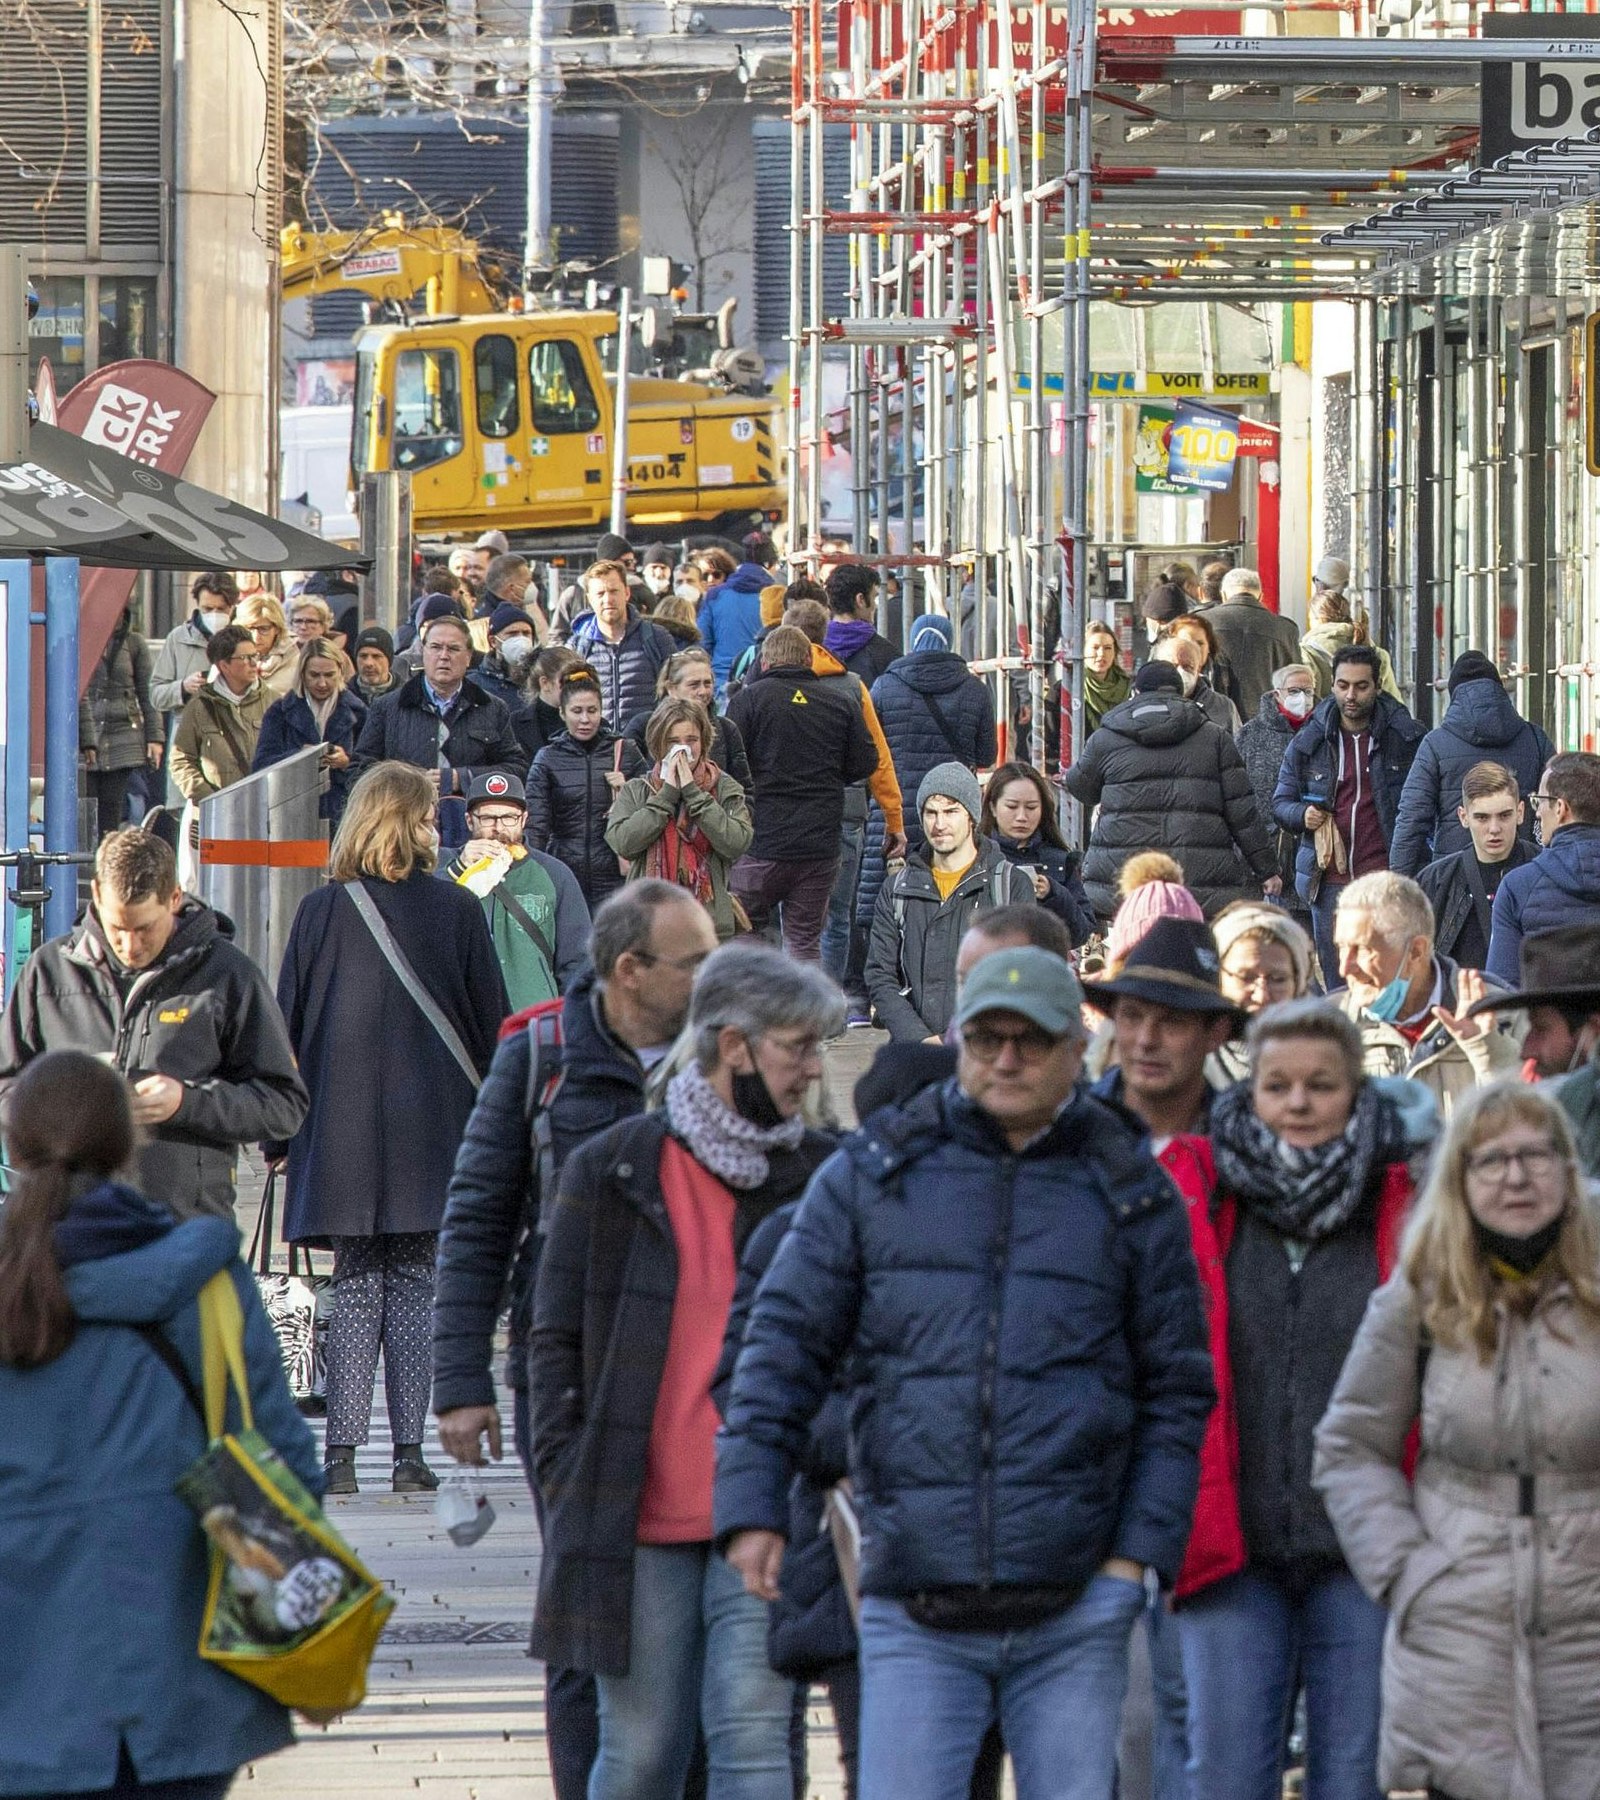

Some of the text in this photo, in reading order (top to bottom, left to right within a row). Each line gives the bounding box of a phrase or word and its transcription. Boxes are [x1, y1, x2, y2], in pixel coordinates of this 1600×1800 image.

[1548, 44, 1593, 53] ALFIX
[1161, 374, 1259, 389] VOITOFER
[736, 422, 750, 437] 19
[1174, 425, 1238, 463] 100
